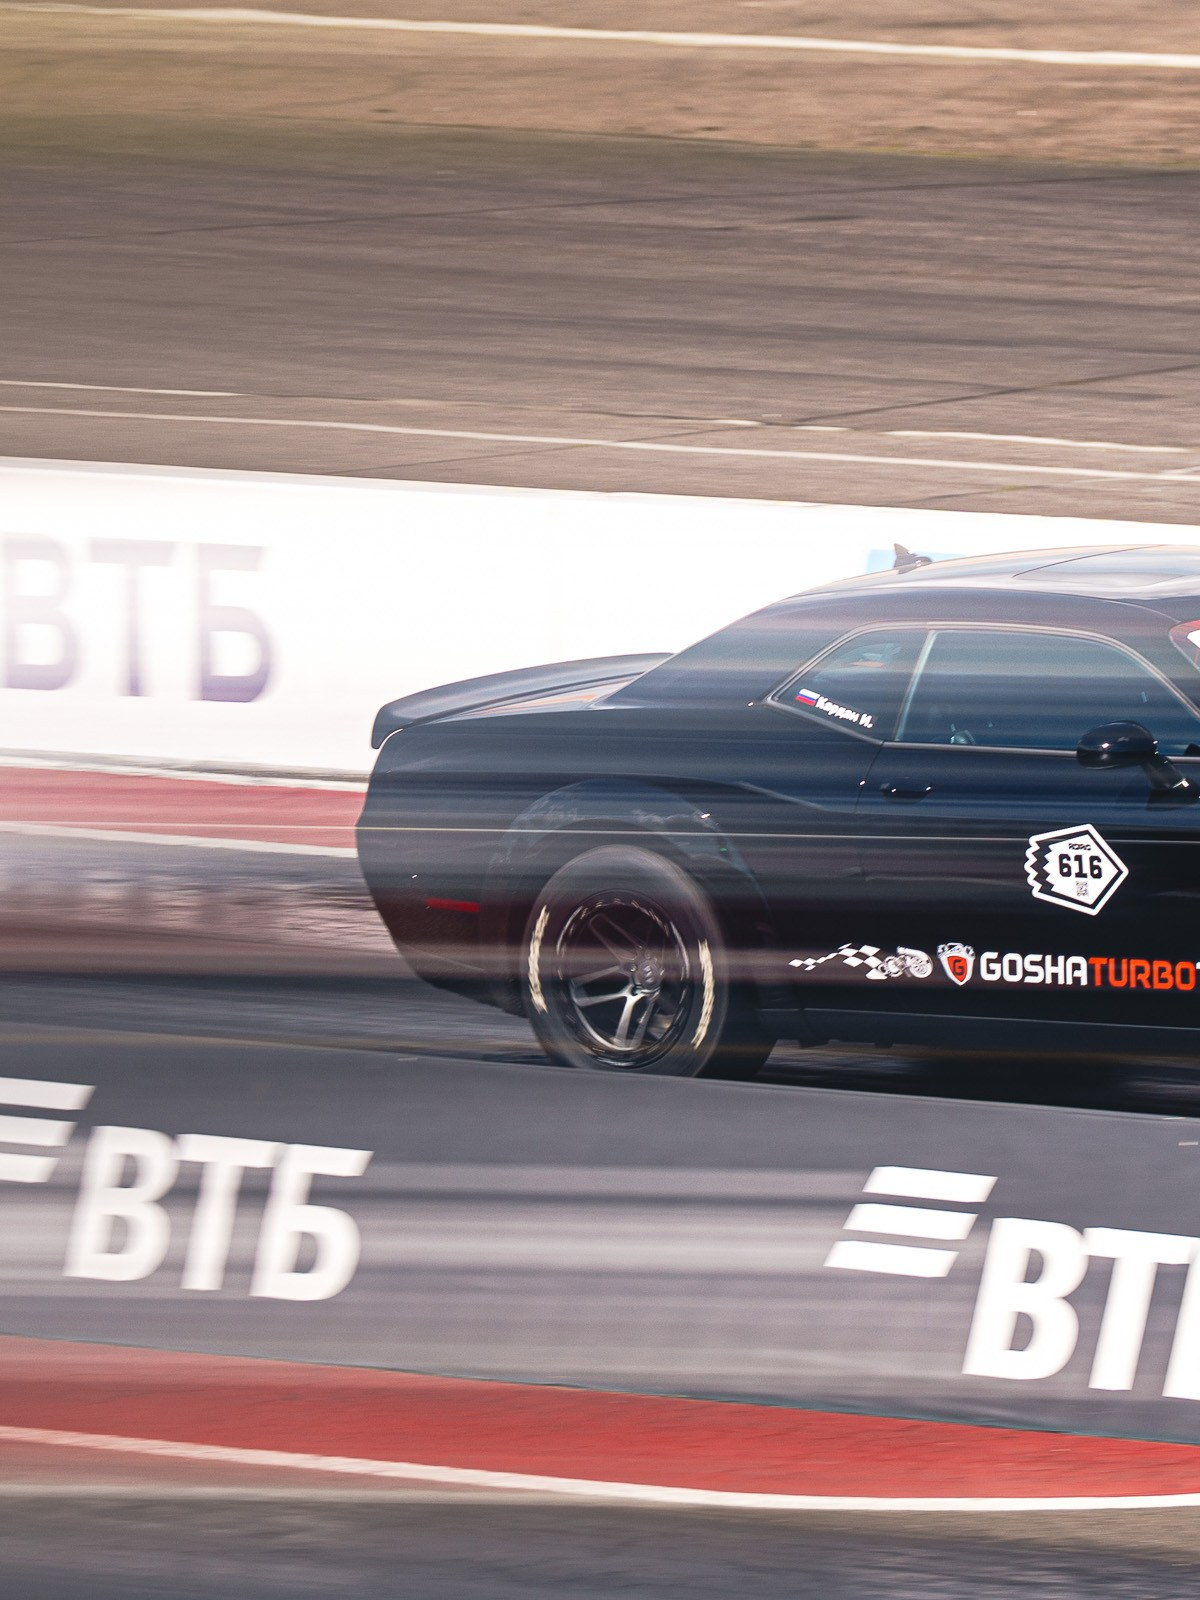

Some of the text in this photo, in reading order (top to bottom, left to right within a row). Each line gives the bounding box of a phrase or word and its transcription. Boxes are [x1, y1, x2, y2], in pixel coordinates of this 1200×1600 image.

[1, 531, 274, 703] ВТБ
[1058, 853, 1103, 879] 616
[64, 1125, 374, 1301] ВТБ
